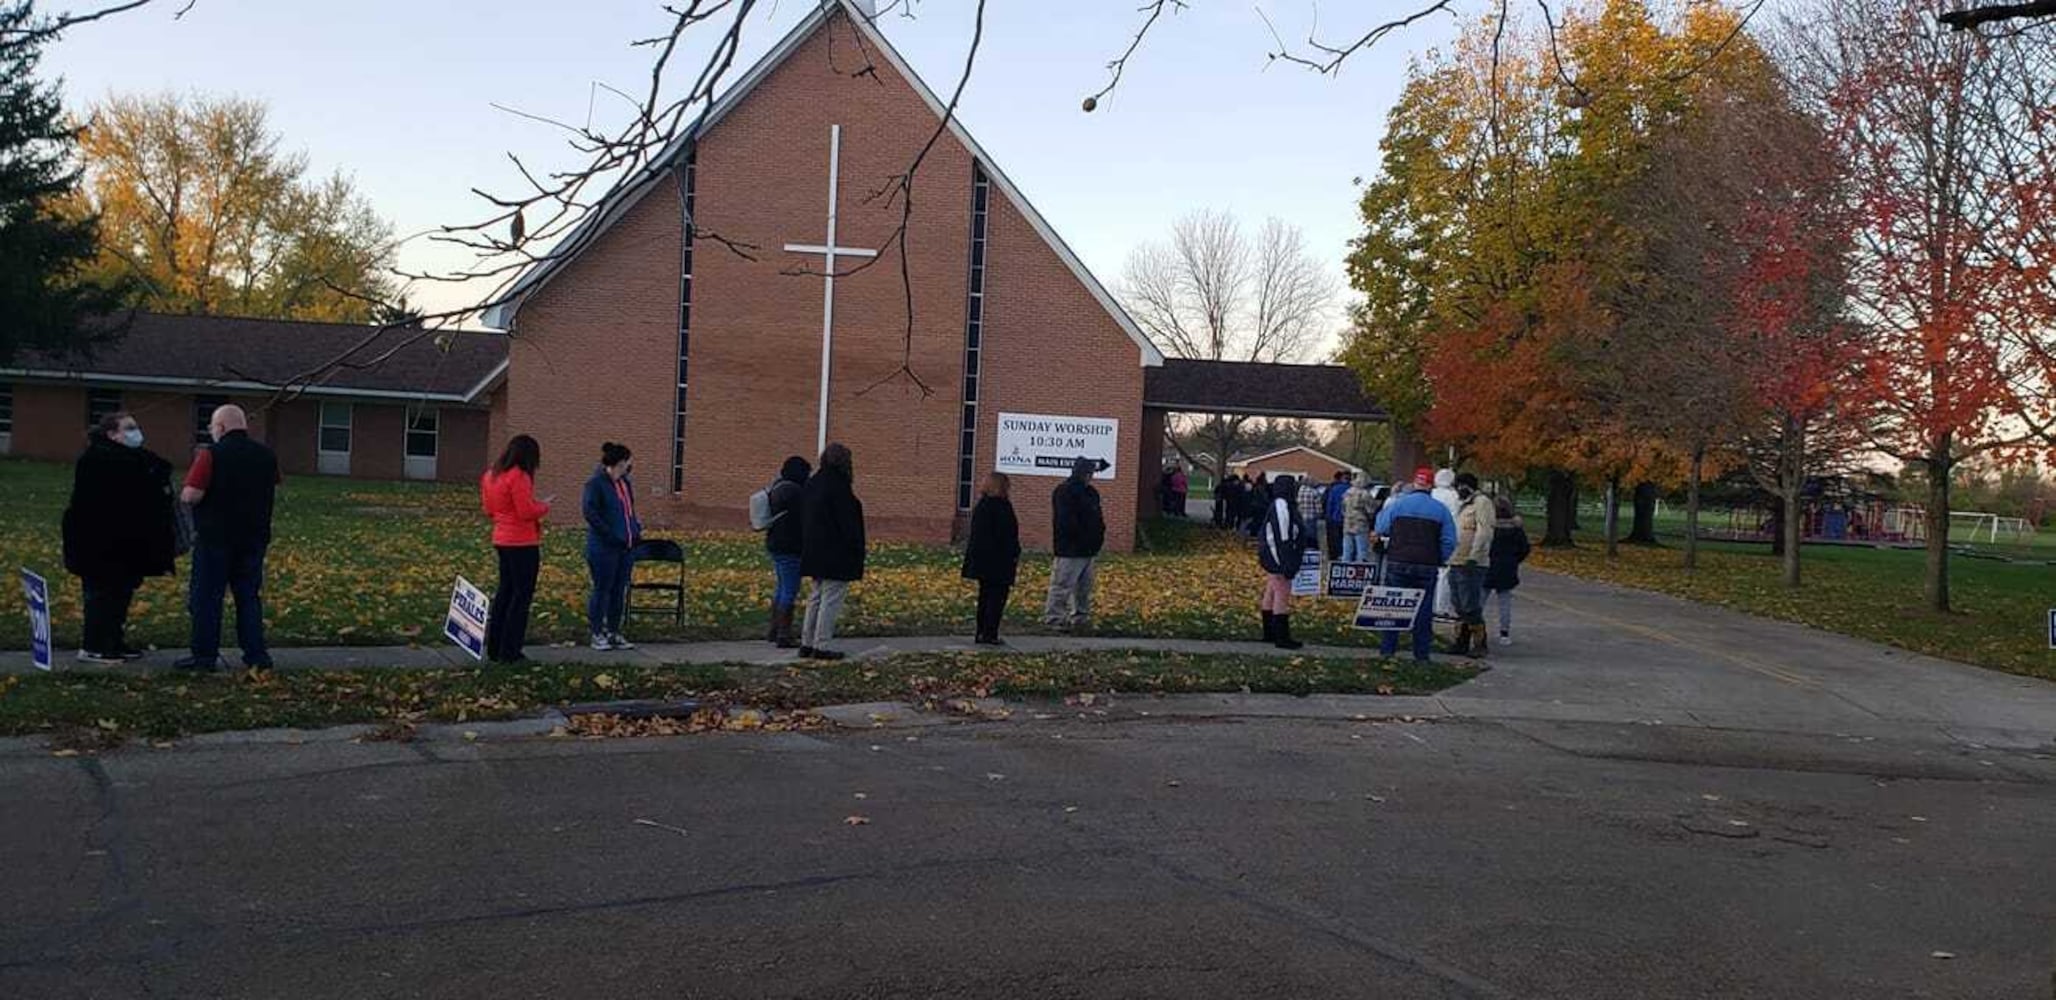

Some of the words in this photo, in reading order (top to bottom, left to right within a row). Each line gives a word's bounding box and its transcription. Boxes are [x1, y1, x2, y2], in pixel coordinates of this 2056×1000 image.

[1003, 420, 1051, 432] SUNDAY
[1055, 422, 1112, 435] WORSHIP
[1030, 436, 1063, 447] 10:30
[1065, 438, 1085, 448] AM
[1038, 457, 1058, 466] MAIN
[1332, 565, 1375, 580] BIDEN
